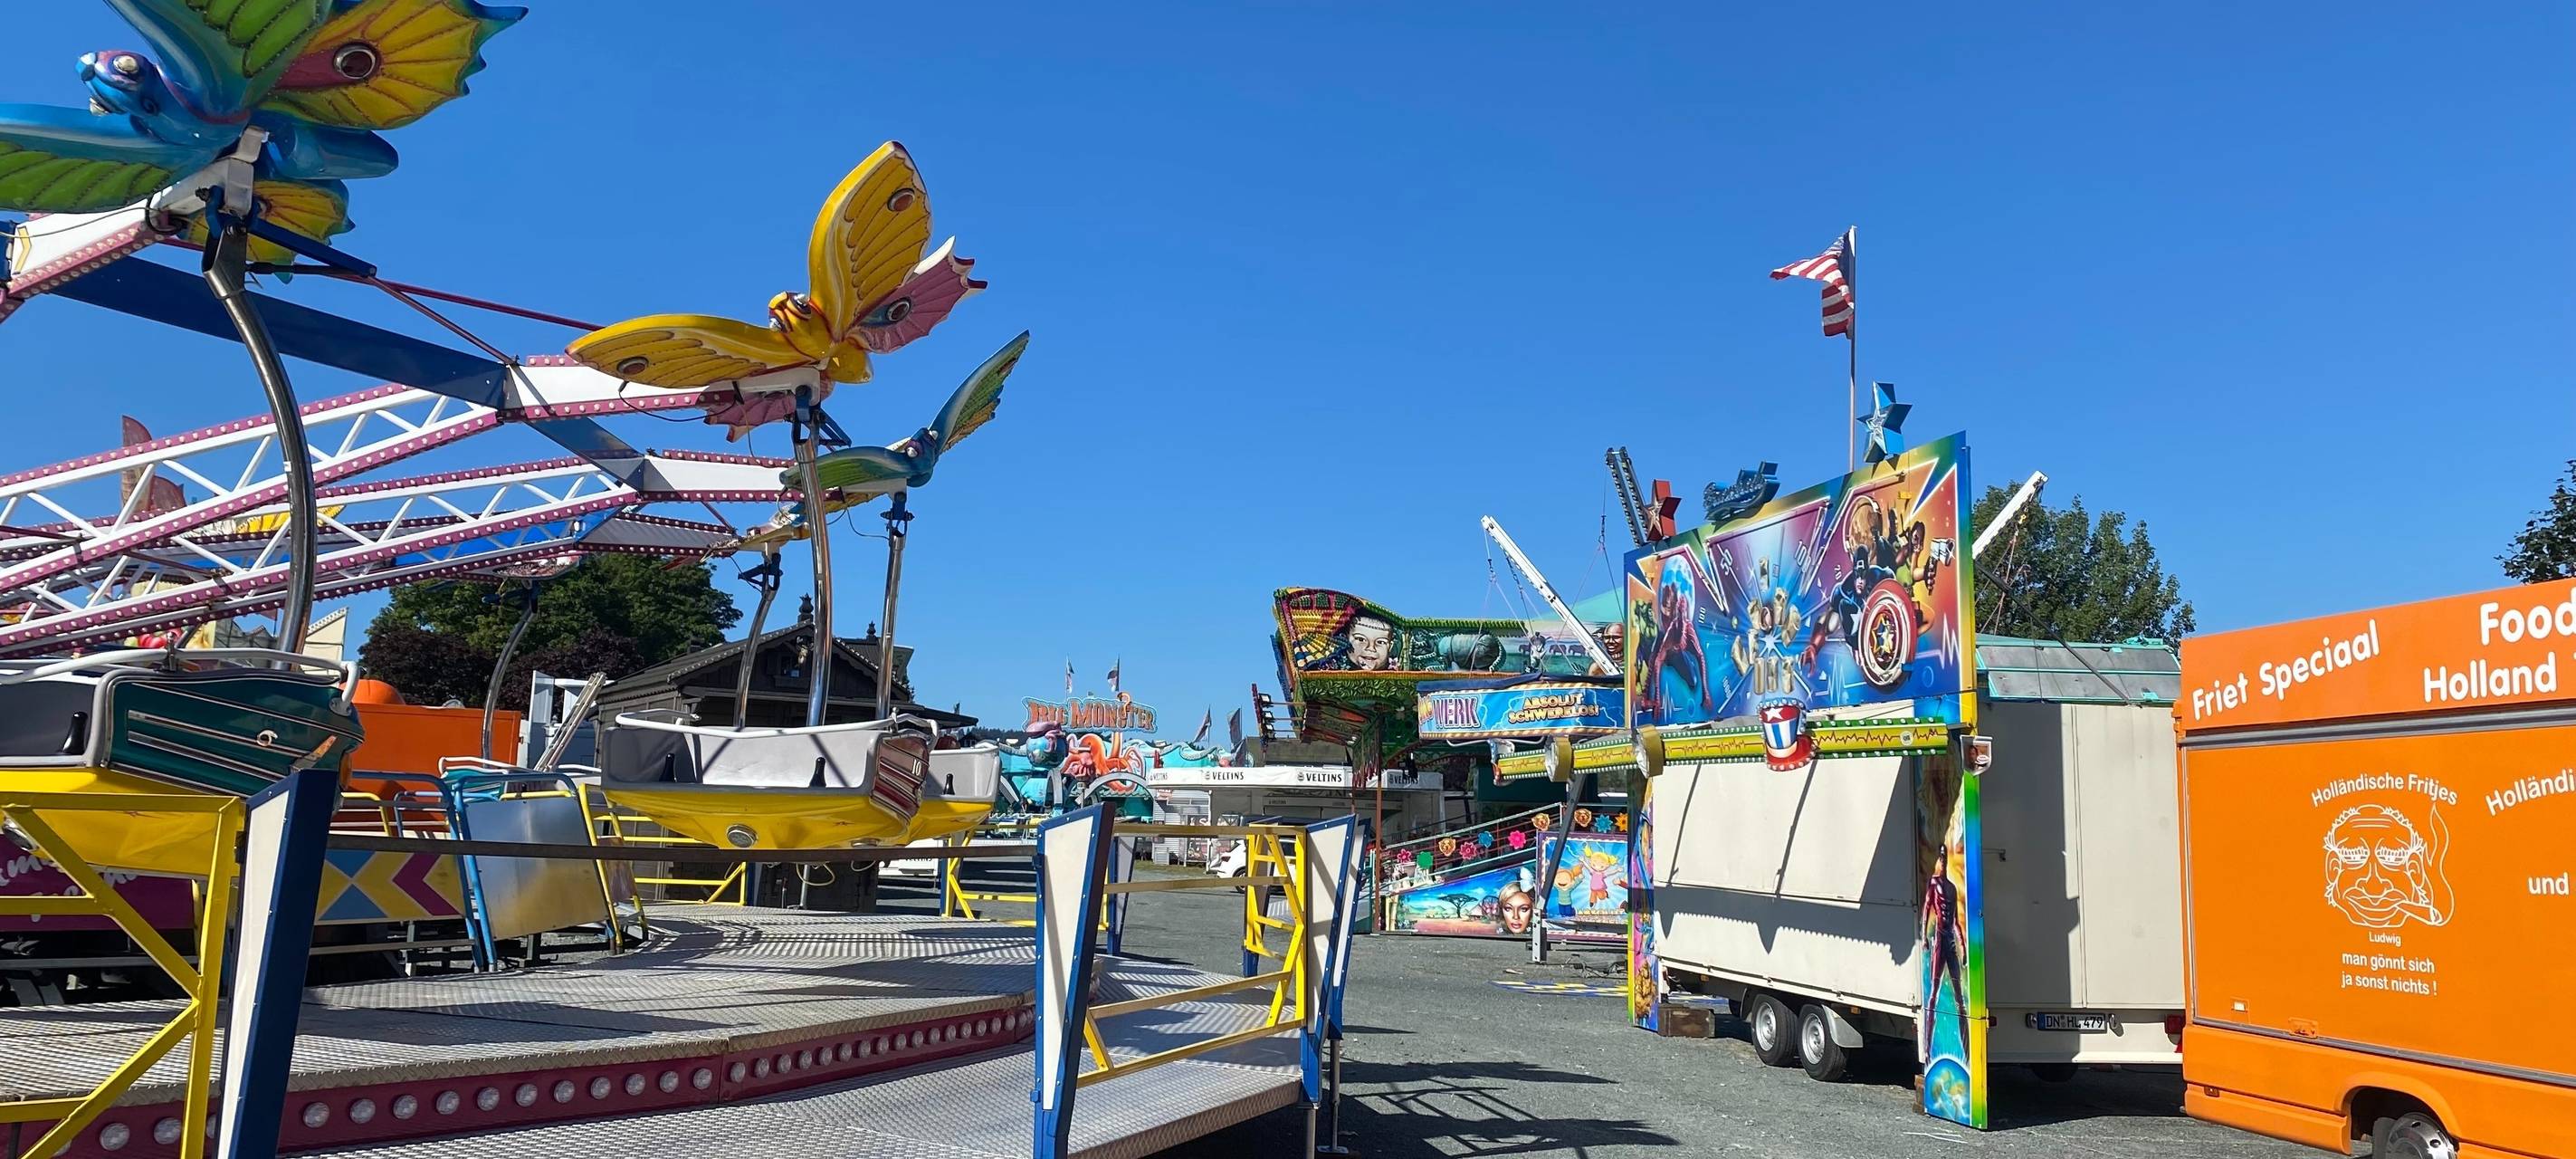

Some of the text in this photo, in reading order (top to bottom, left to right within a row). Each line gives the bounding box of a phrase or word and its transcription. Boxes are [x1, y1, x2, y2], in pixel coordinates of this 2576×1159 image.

[2480, 587, 2576, 646] Food
[2191, 618, 2380, 721] Friet Speciaal
[2423, 651, 2557, 704] Holland
[1433, 697, 1480, 727] WERK
[1508, 704, 1599, 723] SCHWERELOS!
[1523, 693, 1584, 710] ABSOLUT
[1027, 698, 1154, 731] BIG MONSTER
[911, 759, 921, 776] 10
[1212, 771, 1245, 781] VELTINS
[1306, 773, 1342, 782] VELTINS
[2312, 772, 2458, 807] Holländische Fritjes
[2485, 769, 2576, 816] Holländi
[2528, 872, 2570, 896] und
[2369, 931, 2401, 947] Ludwig
[2342, 953, 2435, 973] man gönnt sich
[2342, 971, 2438, 996] ja sonst nichts !
[2046, 1015, 2061, 1028] DN
[2084, 1016, 2104, 1029] 479
